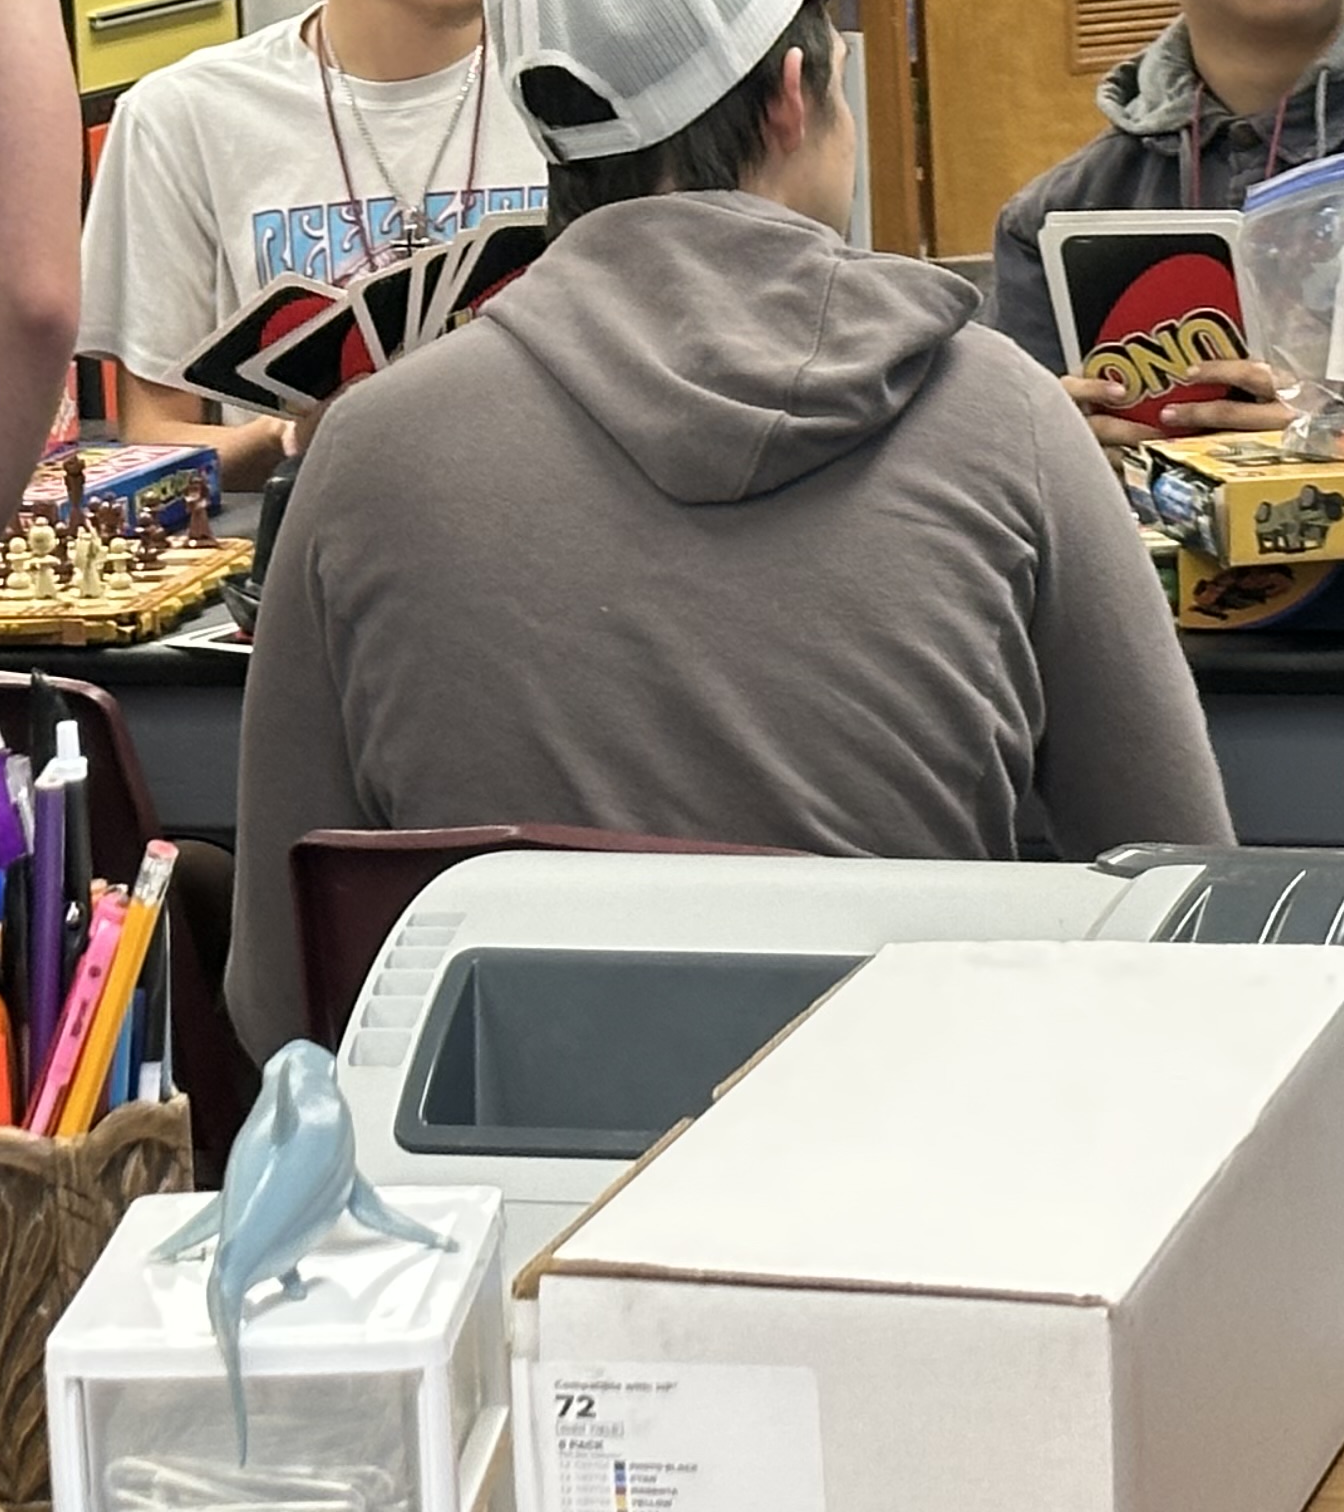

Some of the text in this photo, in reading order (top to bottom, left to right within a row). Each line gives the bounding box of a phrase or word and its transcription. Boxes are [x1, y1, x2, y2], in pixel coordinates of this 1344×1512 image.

[1083, 308, 1246, 409] UNO
[555, 1394, 597, 1419] 72
[569, 1439, 604, 1451] PACK
